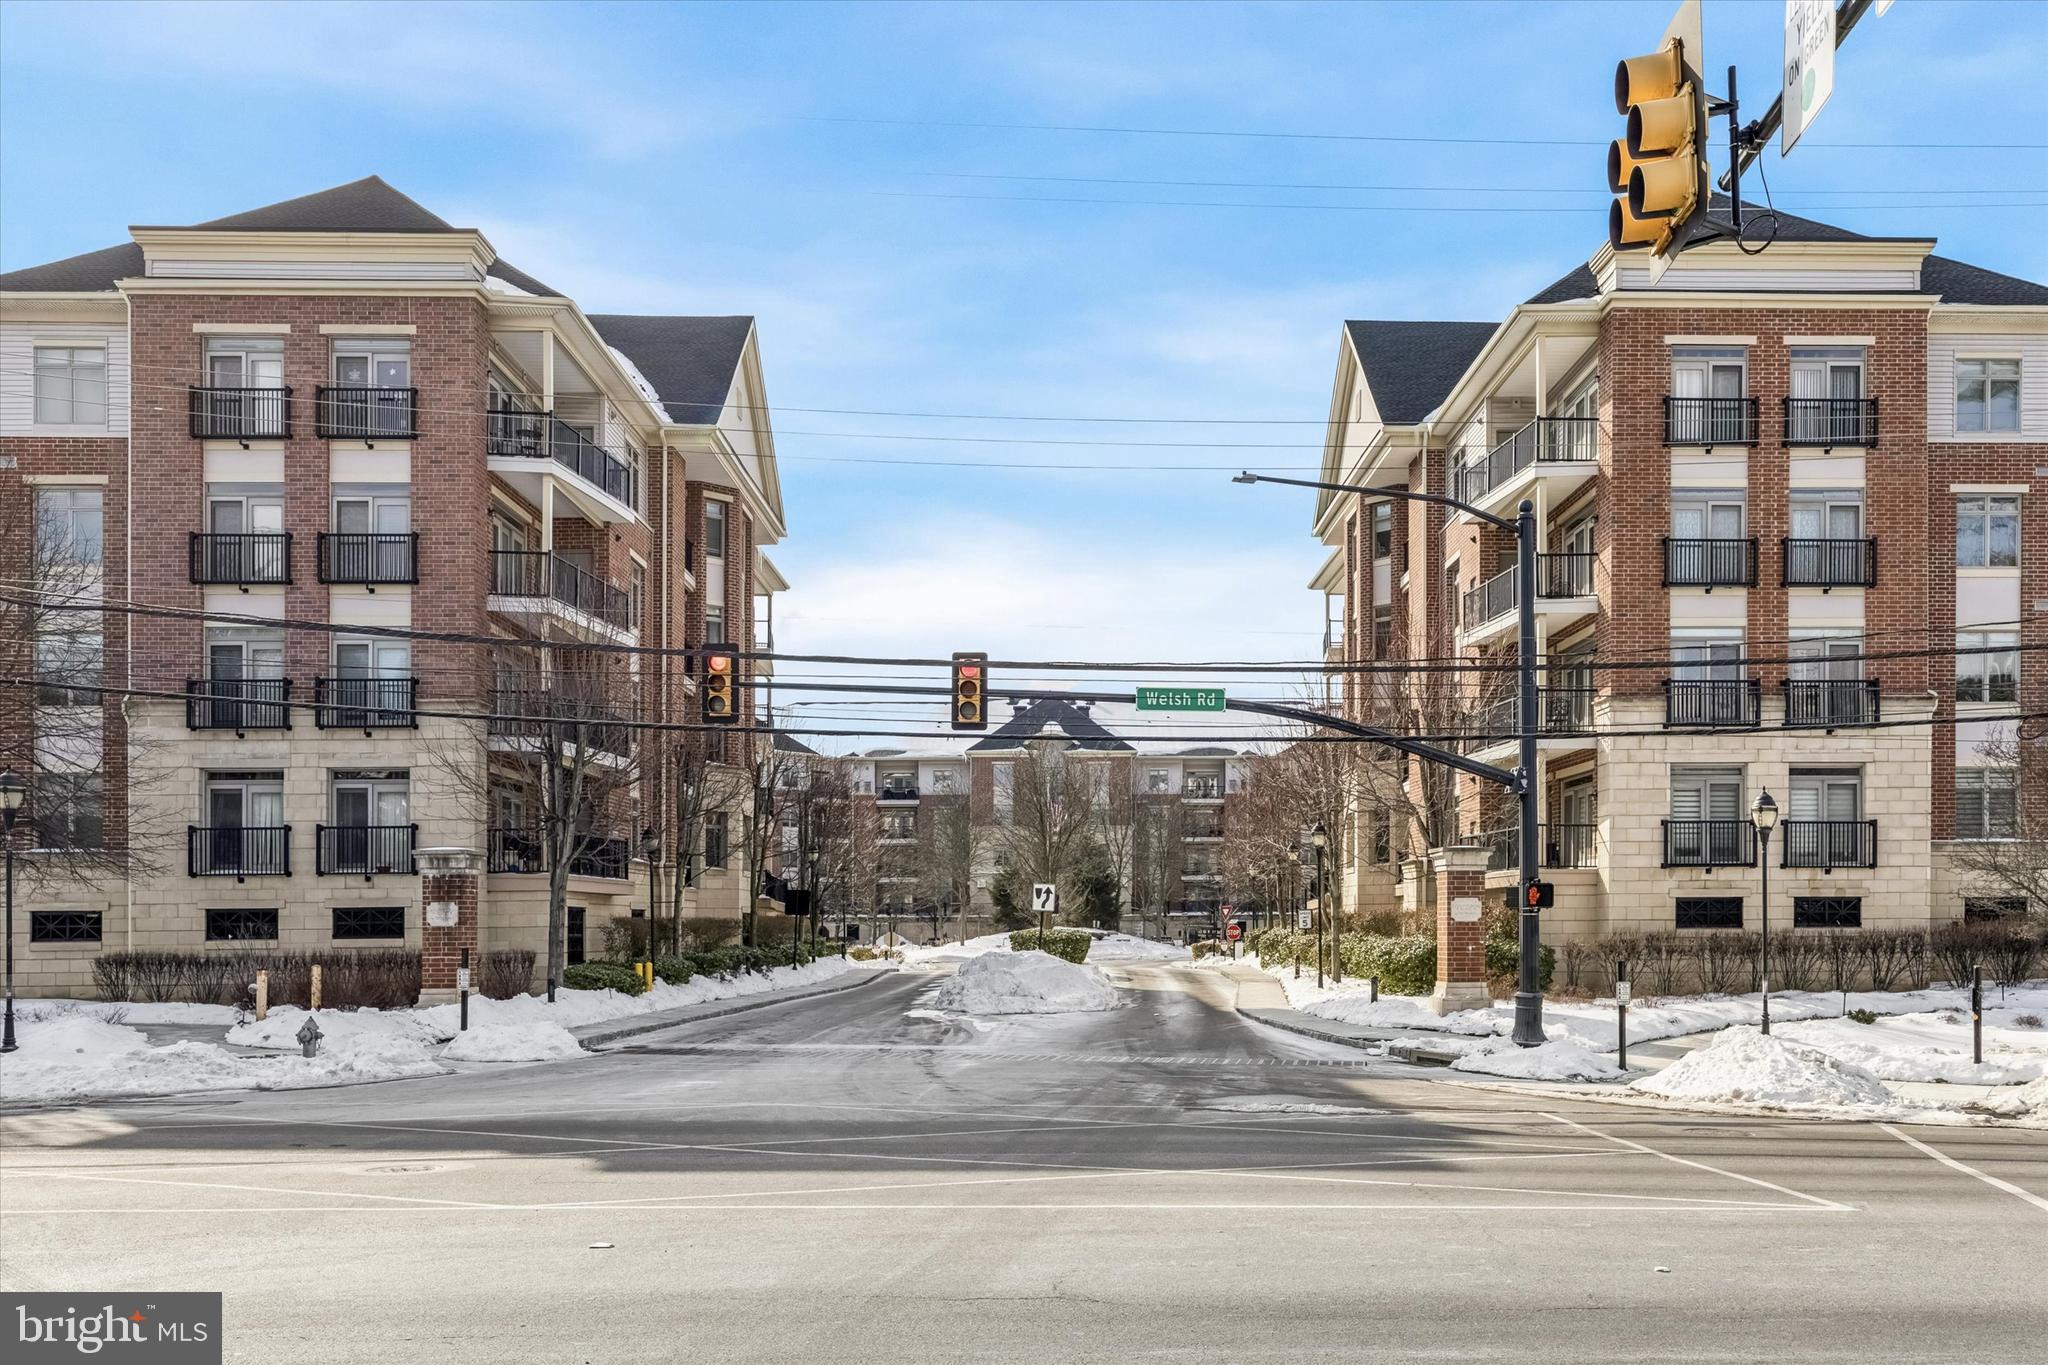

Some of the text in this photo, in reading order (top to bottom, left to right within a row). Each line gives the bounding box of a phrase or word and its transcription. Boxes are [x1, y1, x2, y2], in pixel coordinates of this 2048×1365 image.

[1788, 10, 1830, 87] ON GREEN
[1146, 691, 1215, 706] Welsh Rd
[1302, 919, 1308, 927] 5
